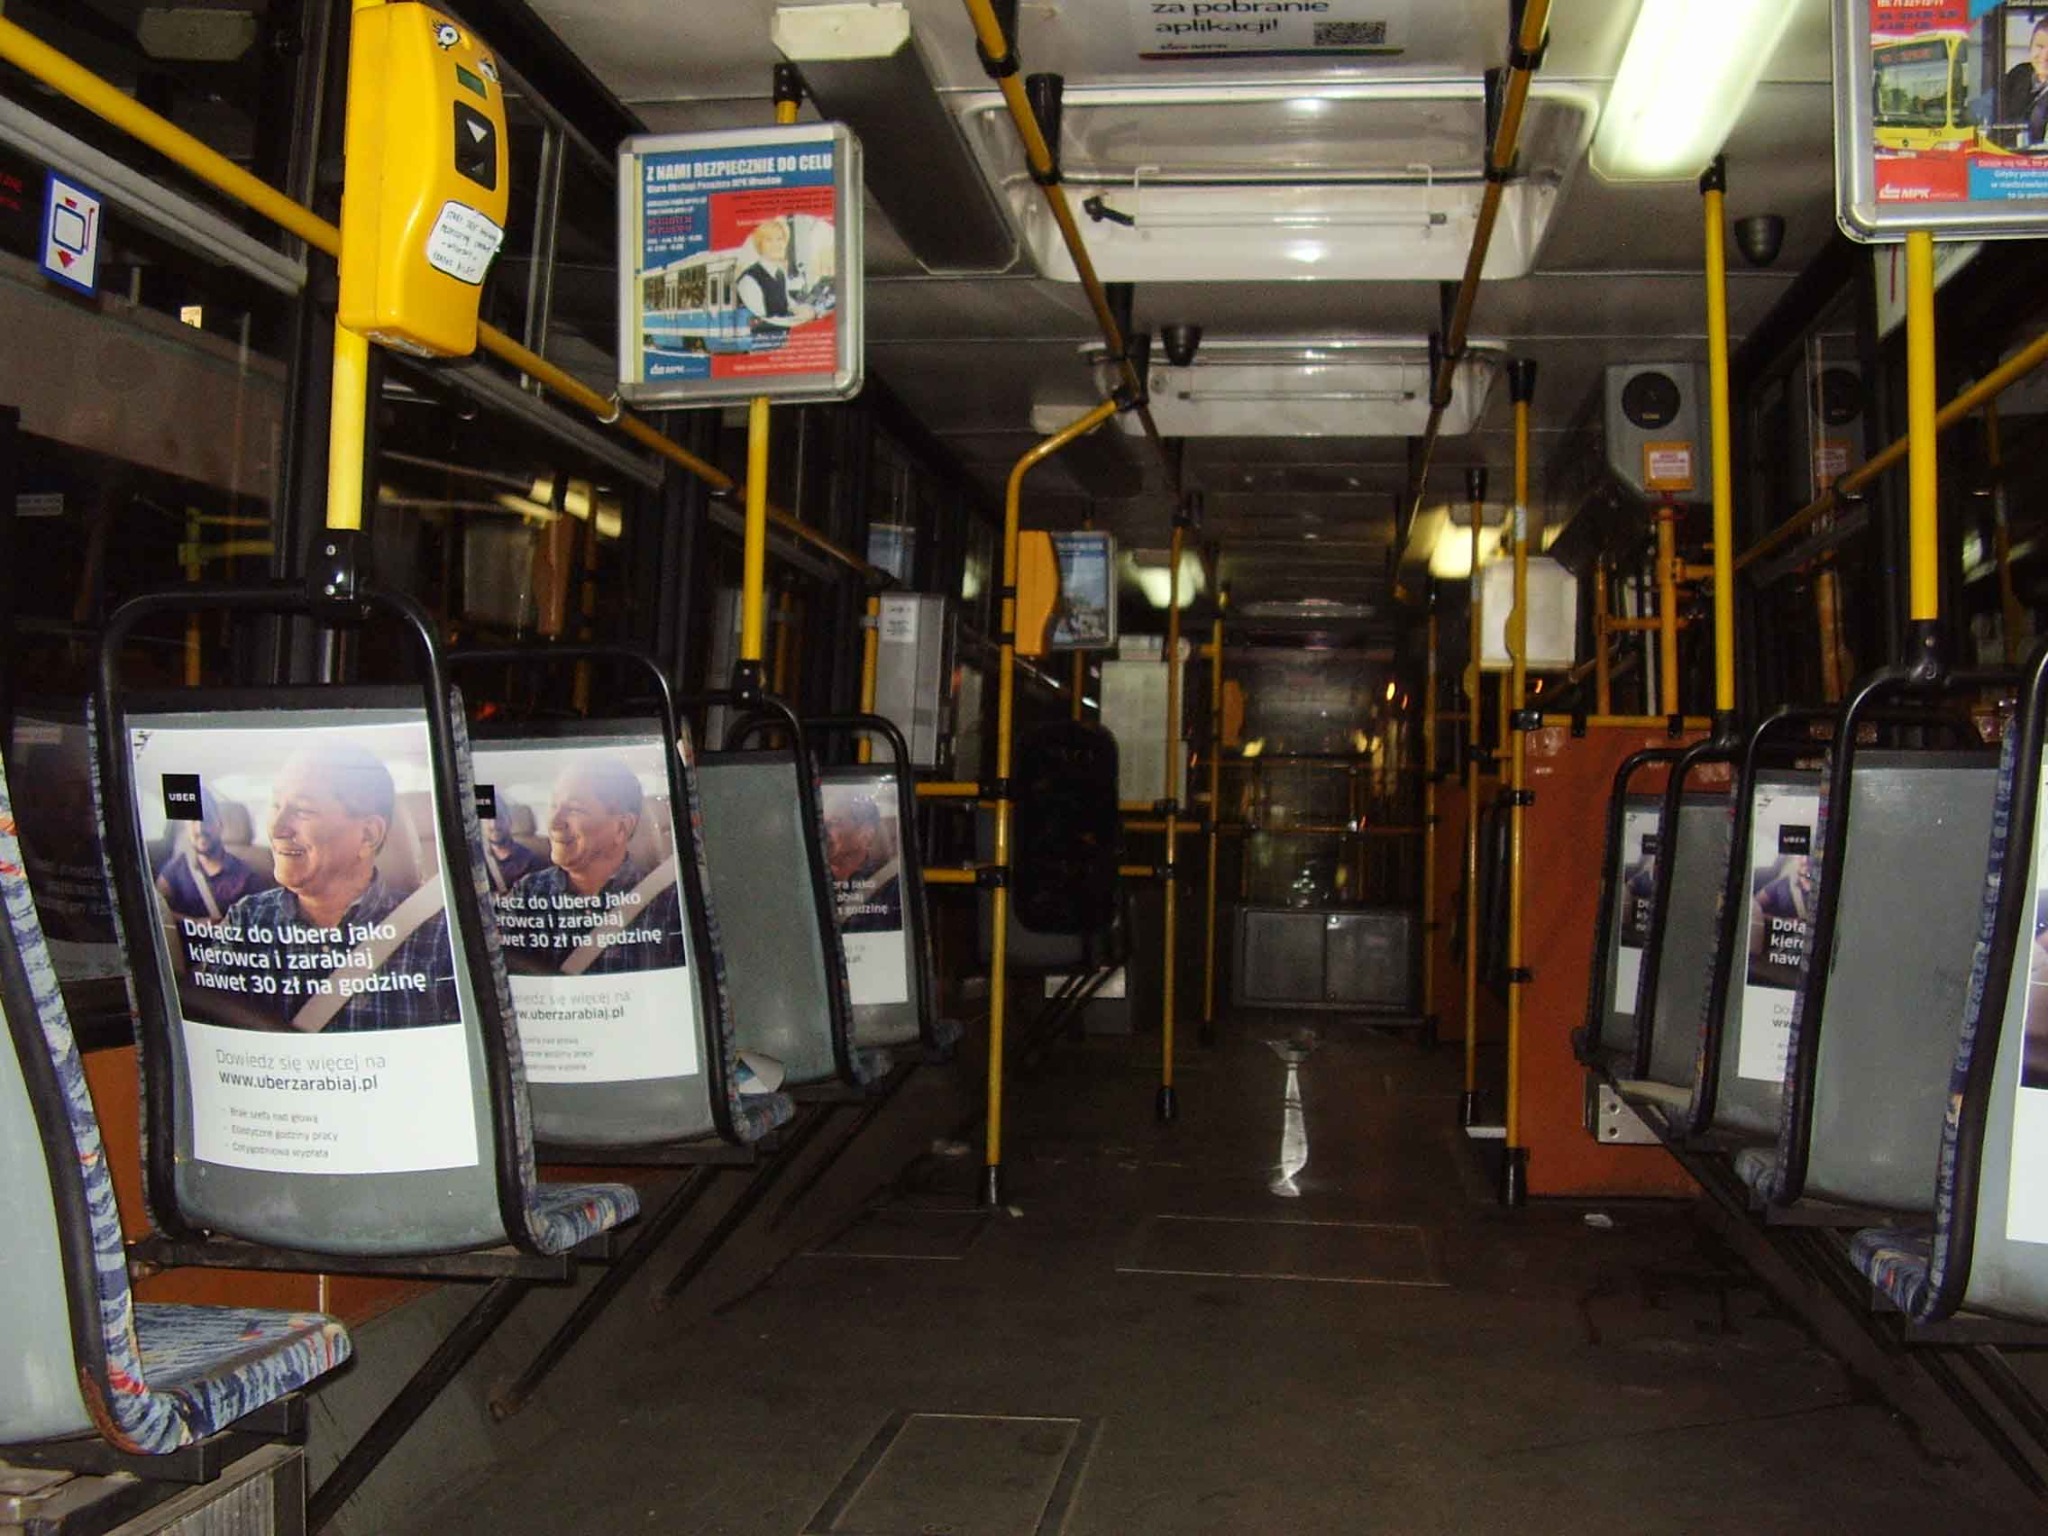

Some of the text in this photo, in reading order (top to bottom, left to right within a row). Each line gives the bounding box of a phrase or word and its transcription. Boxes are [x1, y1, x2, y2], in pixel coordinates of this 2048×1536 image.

[1153, 0, 1330, 16] za pobranie
[1156, 19, 1279, 35] aplikacji!
[646, 153, 833, 181] Z NAMI BEZPIECZNIE DO CELU
[1901, 187, 1931, 199] MPK
[168, 793, 196, 802] UBER
[495, 890, 641, 911] łącz do Ubera jako
[549, 913, 554, 928] i
[558, 911, 624, 929] zarabiaj
[184, 919, 396, 946] Dołącz do Ubera jako
[501, 928, 662, 949] wet 30 zł na godzinę
[189, 944, 373, 970] kierowca i zarabiaj
[1769, 952, 1800, 967] naw
[194, 970, 427, 996] nawet 30 zł na godzinę
[519, 1006, 624, 1021] w.uberzarabiaj.pl
[215, 1049, 386, 1072] Dowiedz się więcej na
[219, 1071, 378, 1093] www.uberzarabiaj.pl
